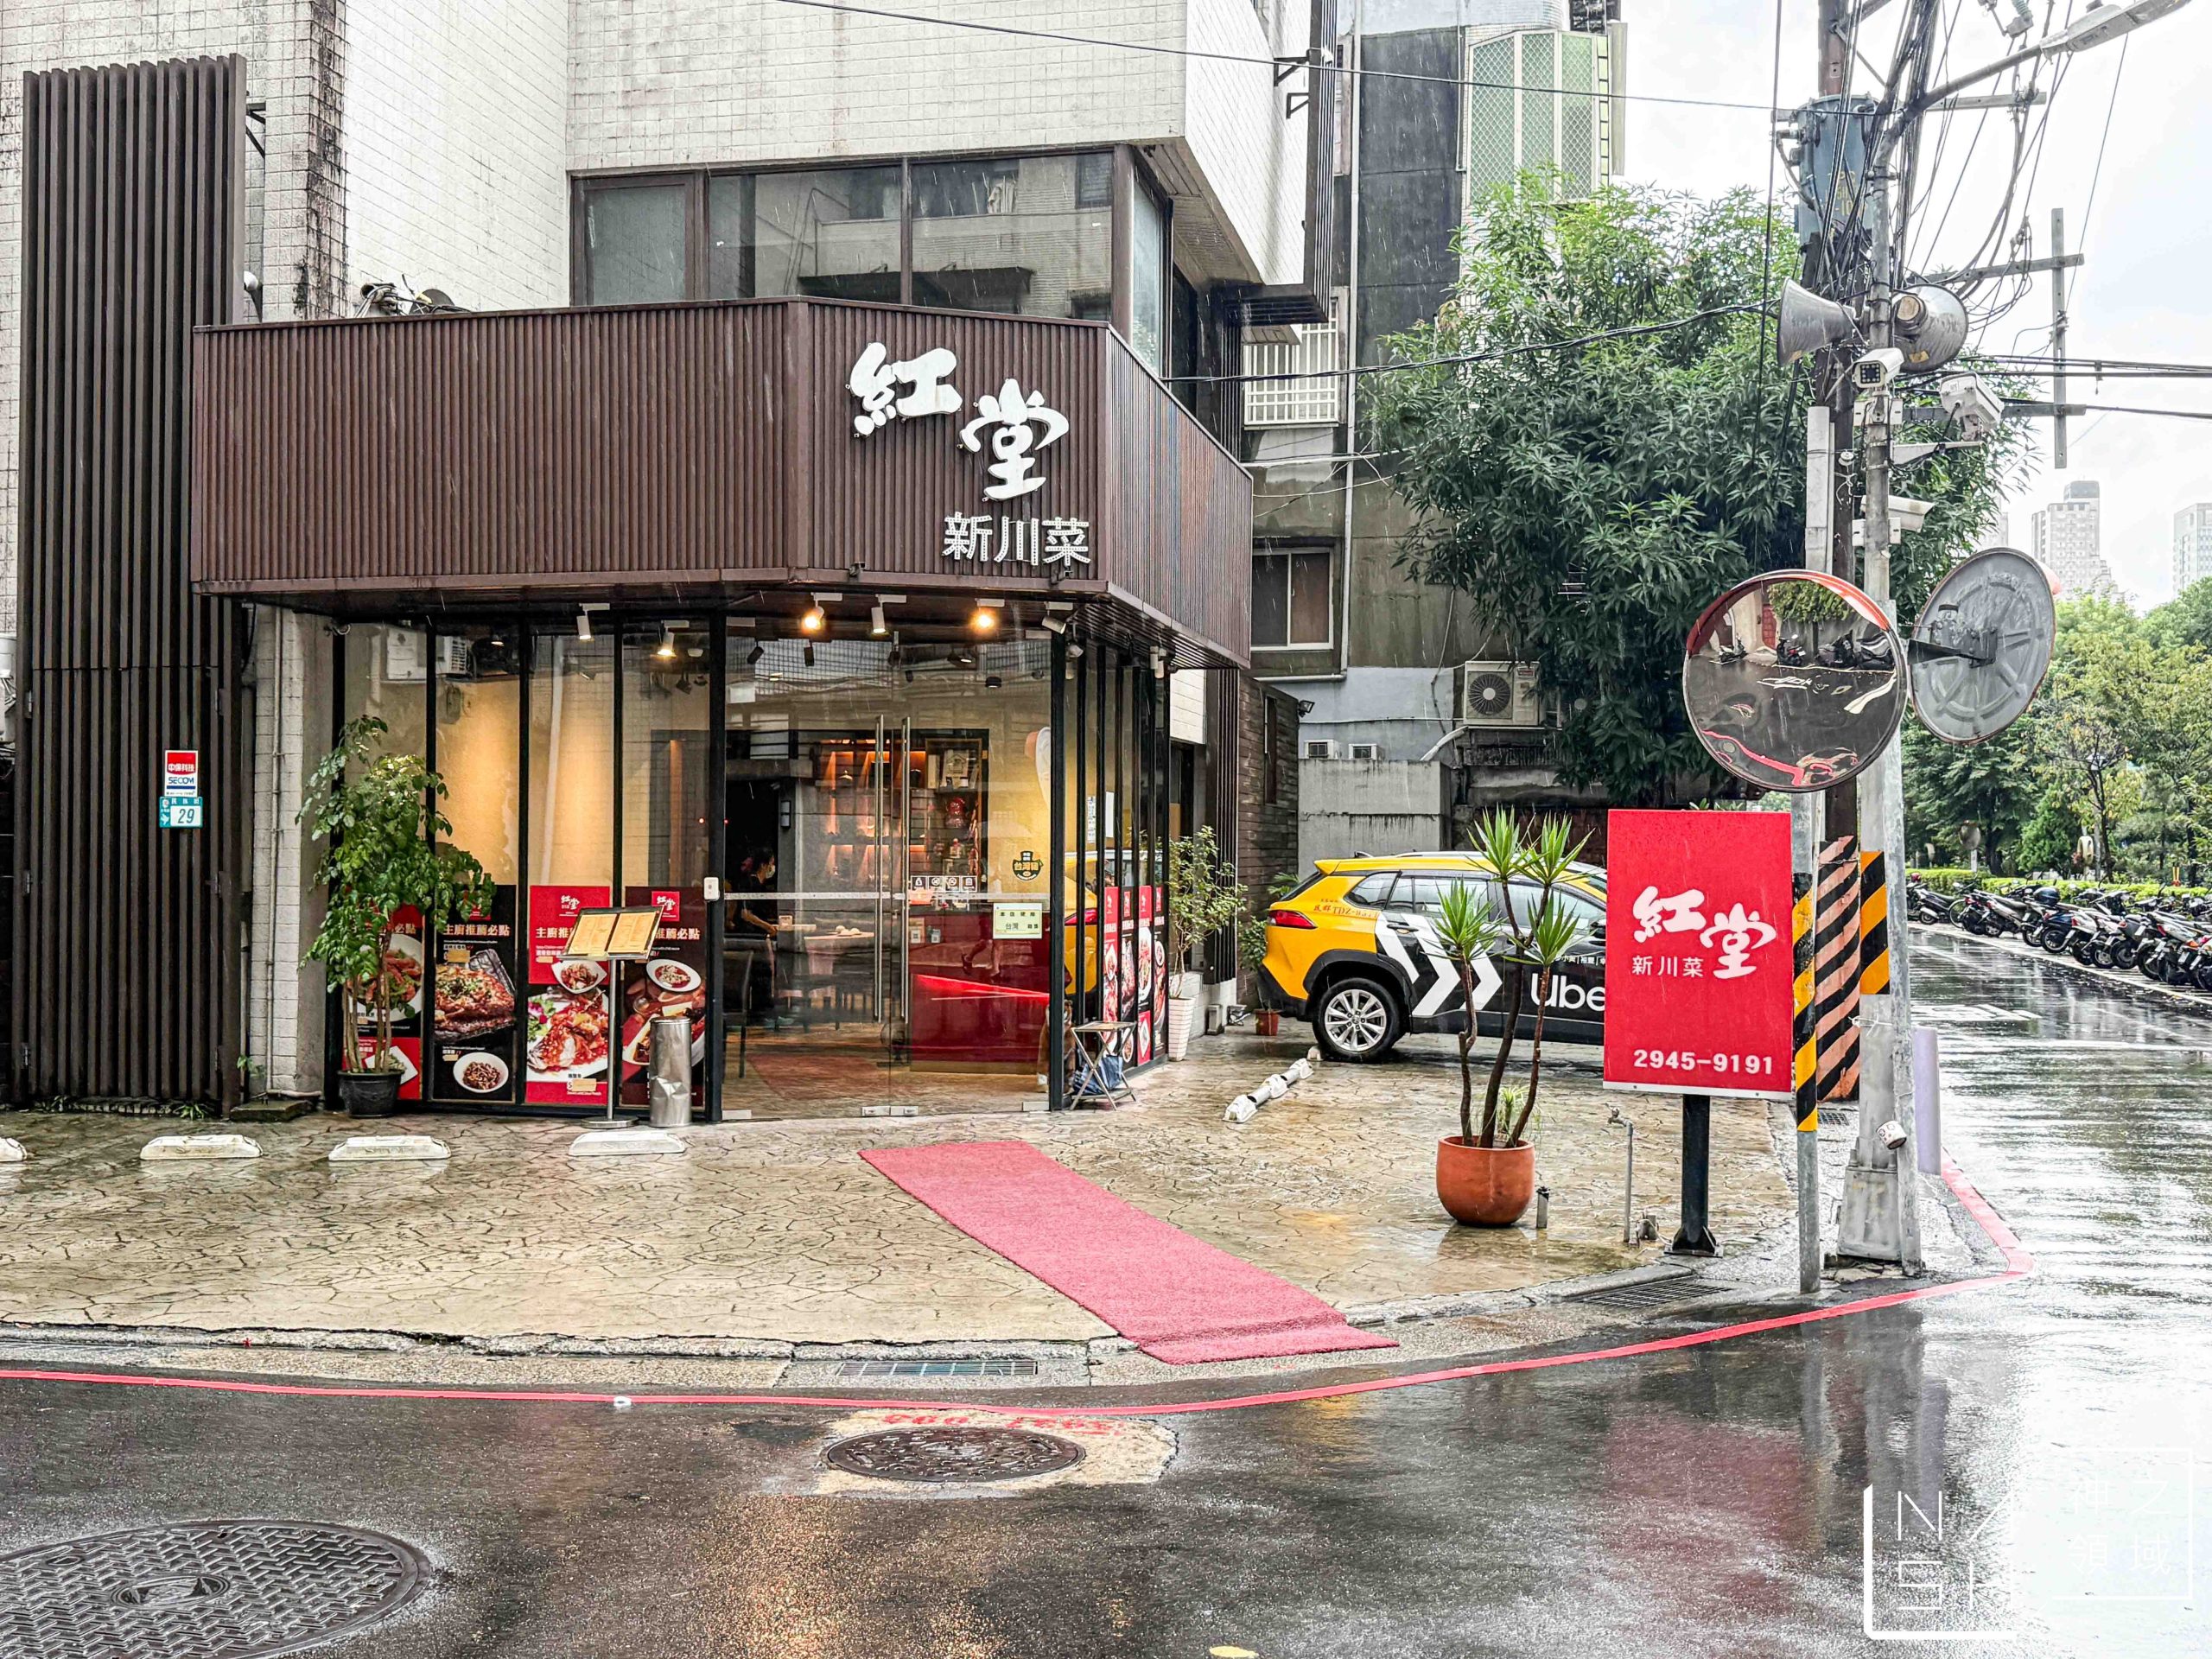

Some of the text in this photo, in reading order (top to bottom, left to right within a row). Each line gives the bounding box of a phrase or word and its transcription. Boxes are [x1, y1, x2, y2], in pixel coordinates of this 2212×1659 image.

[850, 342, 1070, 501] 紅堂
[943, 512, 1091, 568] 新川菜
[168, 776, 194, 785] SECOM
[178, 809, 194, 823] 29
[443, 924, 512, 937] 主廚推薦必點
[1632, 887, 1777, 979] 紅堂
[1631, 955, 1705, 979] 新川菜
[1633, 1048, 1773, 1075] 2945-9191
